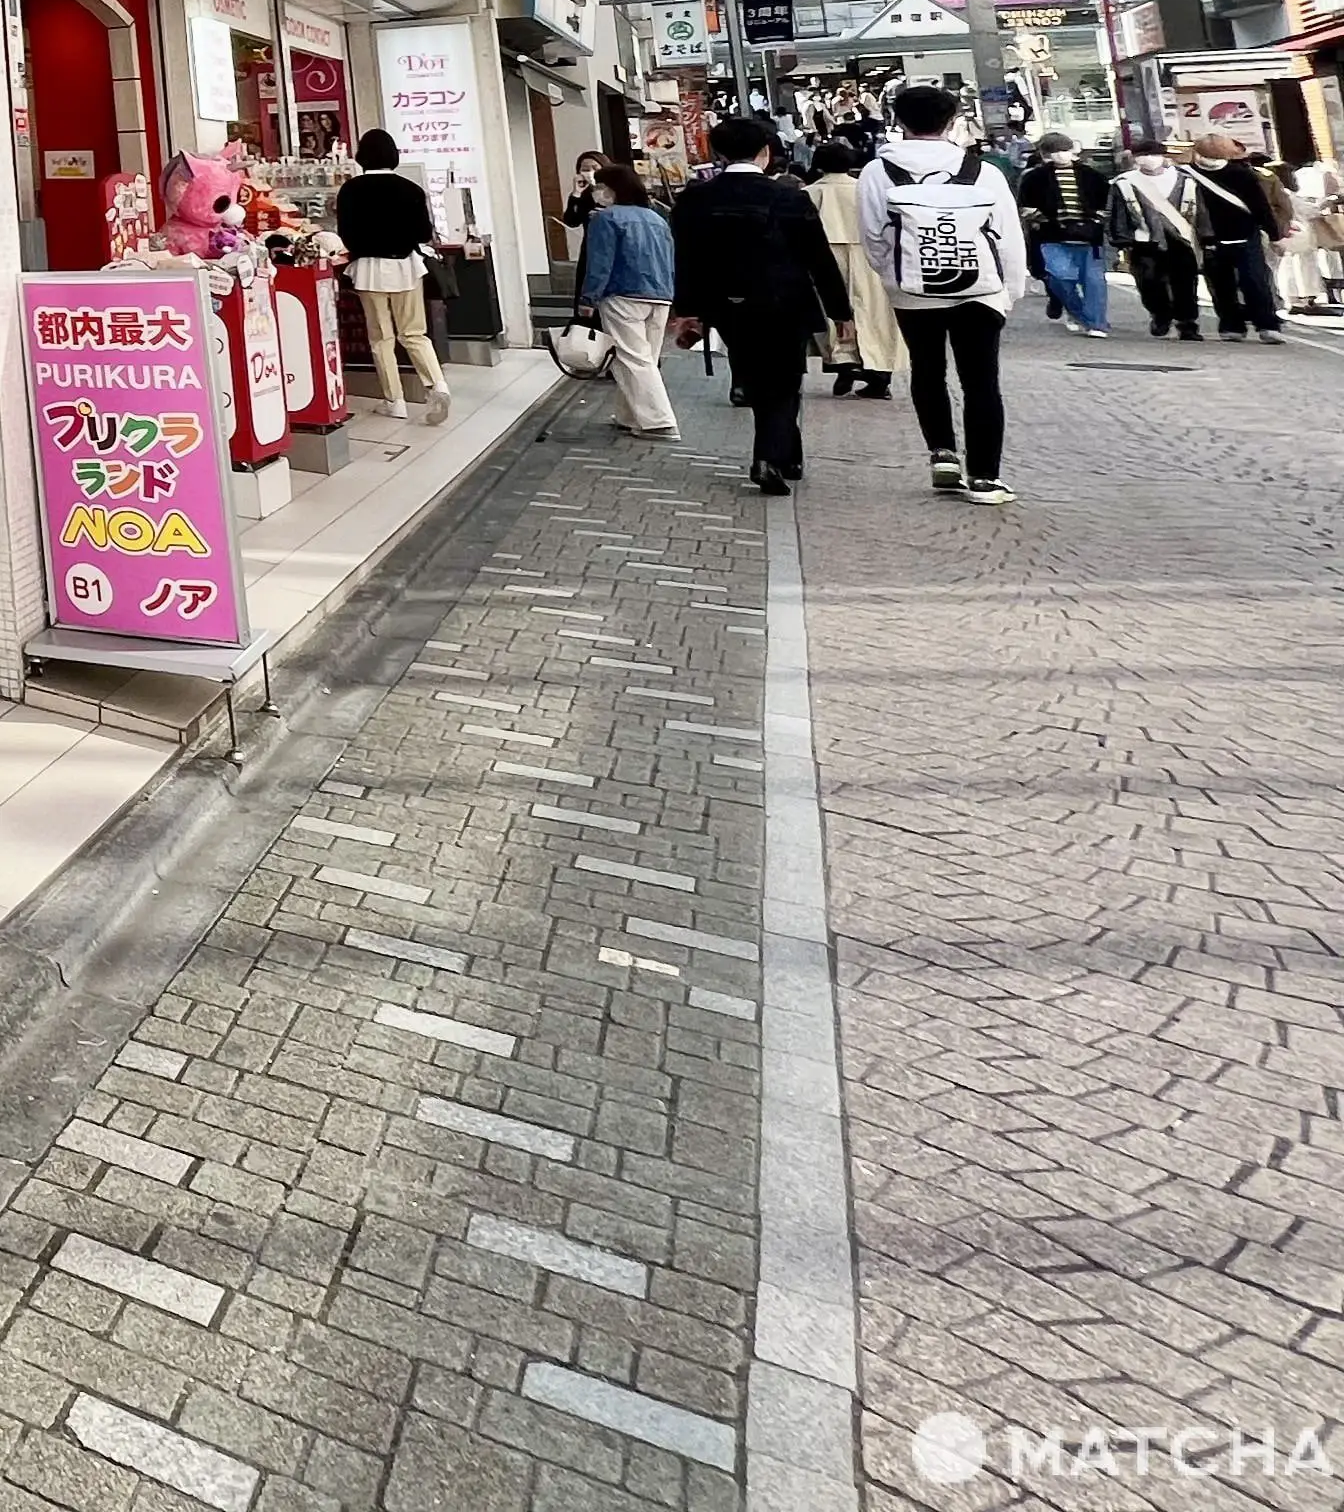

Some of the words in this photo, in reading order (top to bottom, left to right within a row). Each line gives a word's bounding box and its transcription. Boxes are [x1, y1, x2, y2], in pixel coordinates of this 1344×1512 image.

[392, 90, 466, 108] カラコン
[402, 121, 463, 132] ハイパワー
[917, 226, 940, 267] FACE
[935, 211, 961, 268] NORTH
[958, 240, 979, 268] THE
[38, 310, 187, 347] 都内最大
[36, 363, 203, 390] PURIKURA
[46, 402, 200, 454] プリクラ
[75, 462, 175, 499] ランド
[63, 508, 208, 554] NOA
[73, 576, 103, 603] B1
[145, 582, 213, 614] ノア
